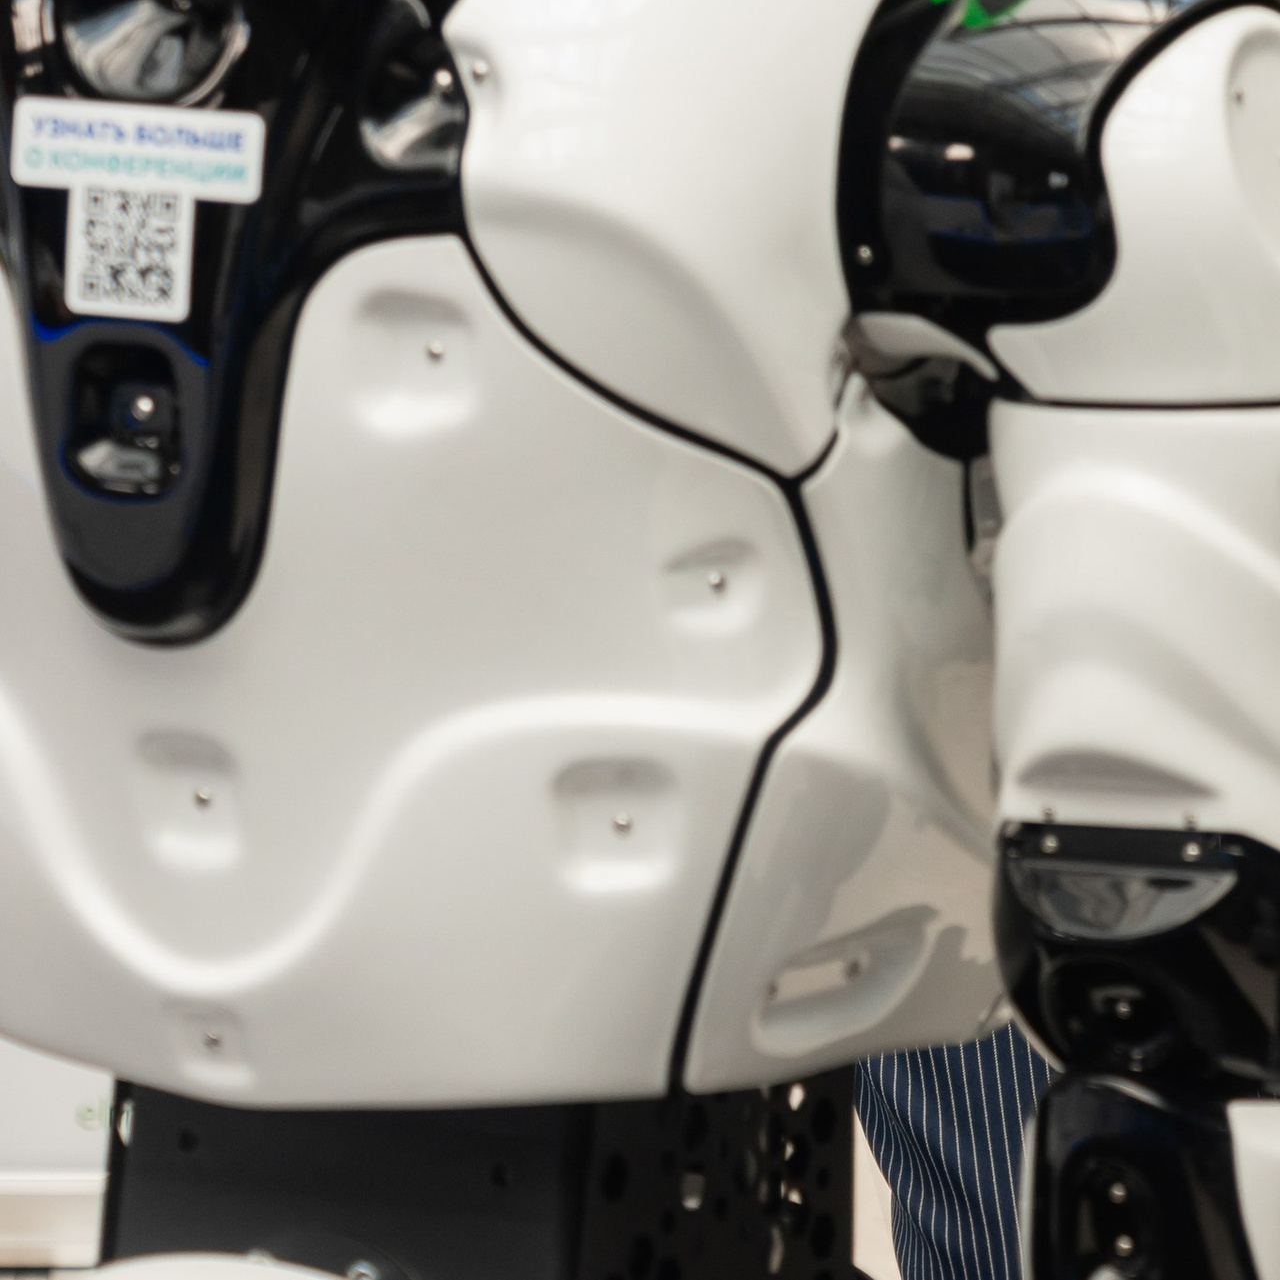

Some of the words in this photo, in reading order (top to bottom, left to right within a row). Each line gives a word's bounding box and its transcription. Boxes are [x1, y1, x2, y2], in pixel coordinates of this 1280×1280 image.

[31, 117, 126, 143] УЗНАТЬ
[135, 123, 244, 152] БОЛЬШЕ
[24, 144, 43, 170] О
[50, 148, 246, 183] КОНФЕРЕНЦИИ
